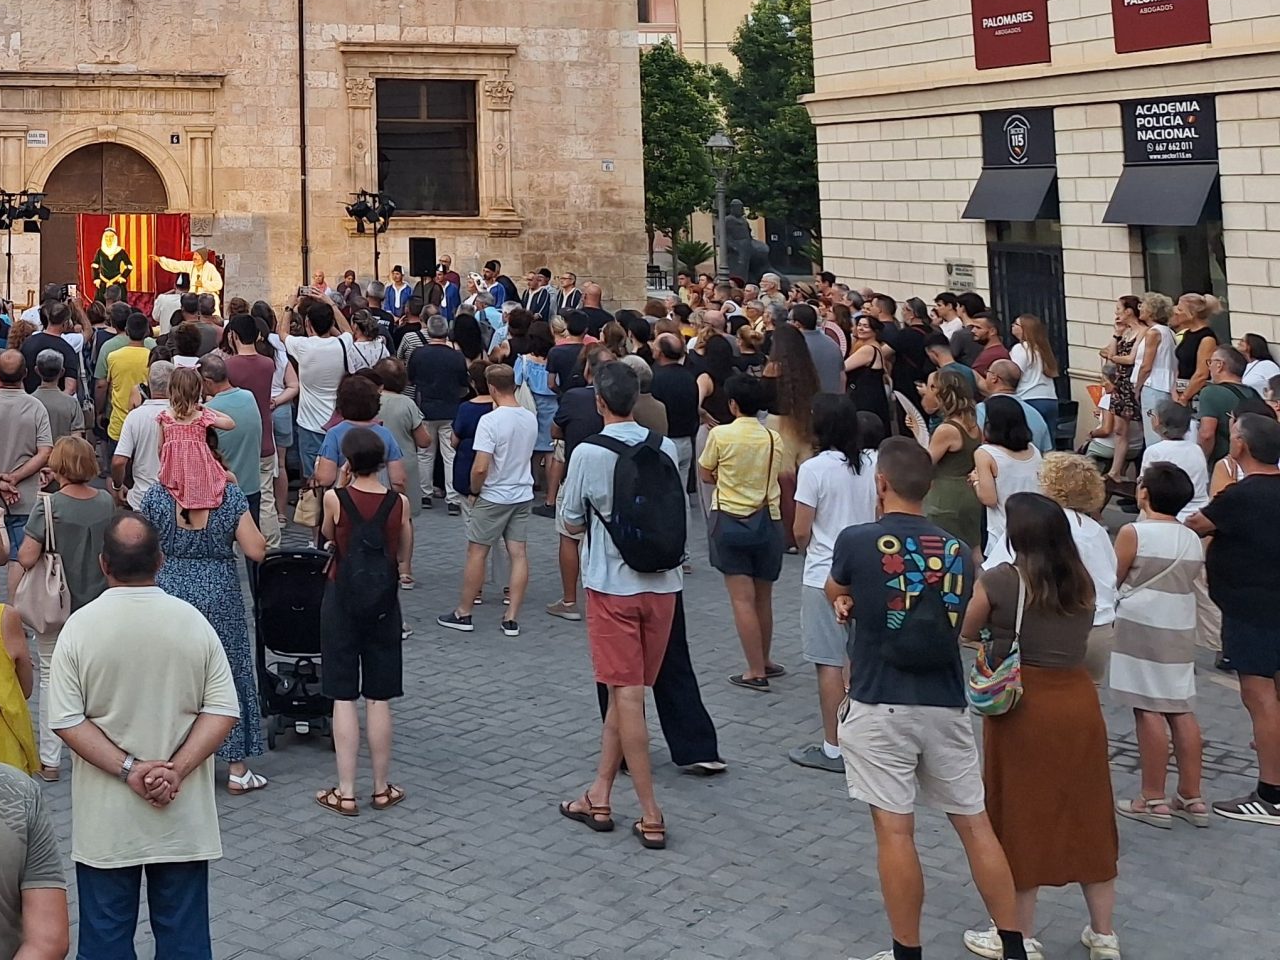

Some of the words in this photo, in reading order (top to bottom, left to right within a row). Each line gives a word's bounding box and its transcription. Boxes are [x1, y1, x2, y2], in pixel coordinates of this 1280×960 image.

[1140, 4, 1173, 14] ABOGADOS
[982, 11, 1033, 28] PALOMARES
[1135, 101, 1200, 115] ACADEMIA
[1136, 113, 1184, 128] POLICÍA
[1011, 134, 1024, 147] 115
[1137, 127, 1200, 141] NACIONAL
